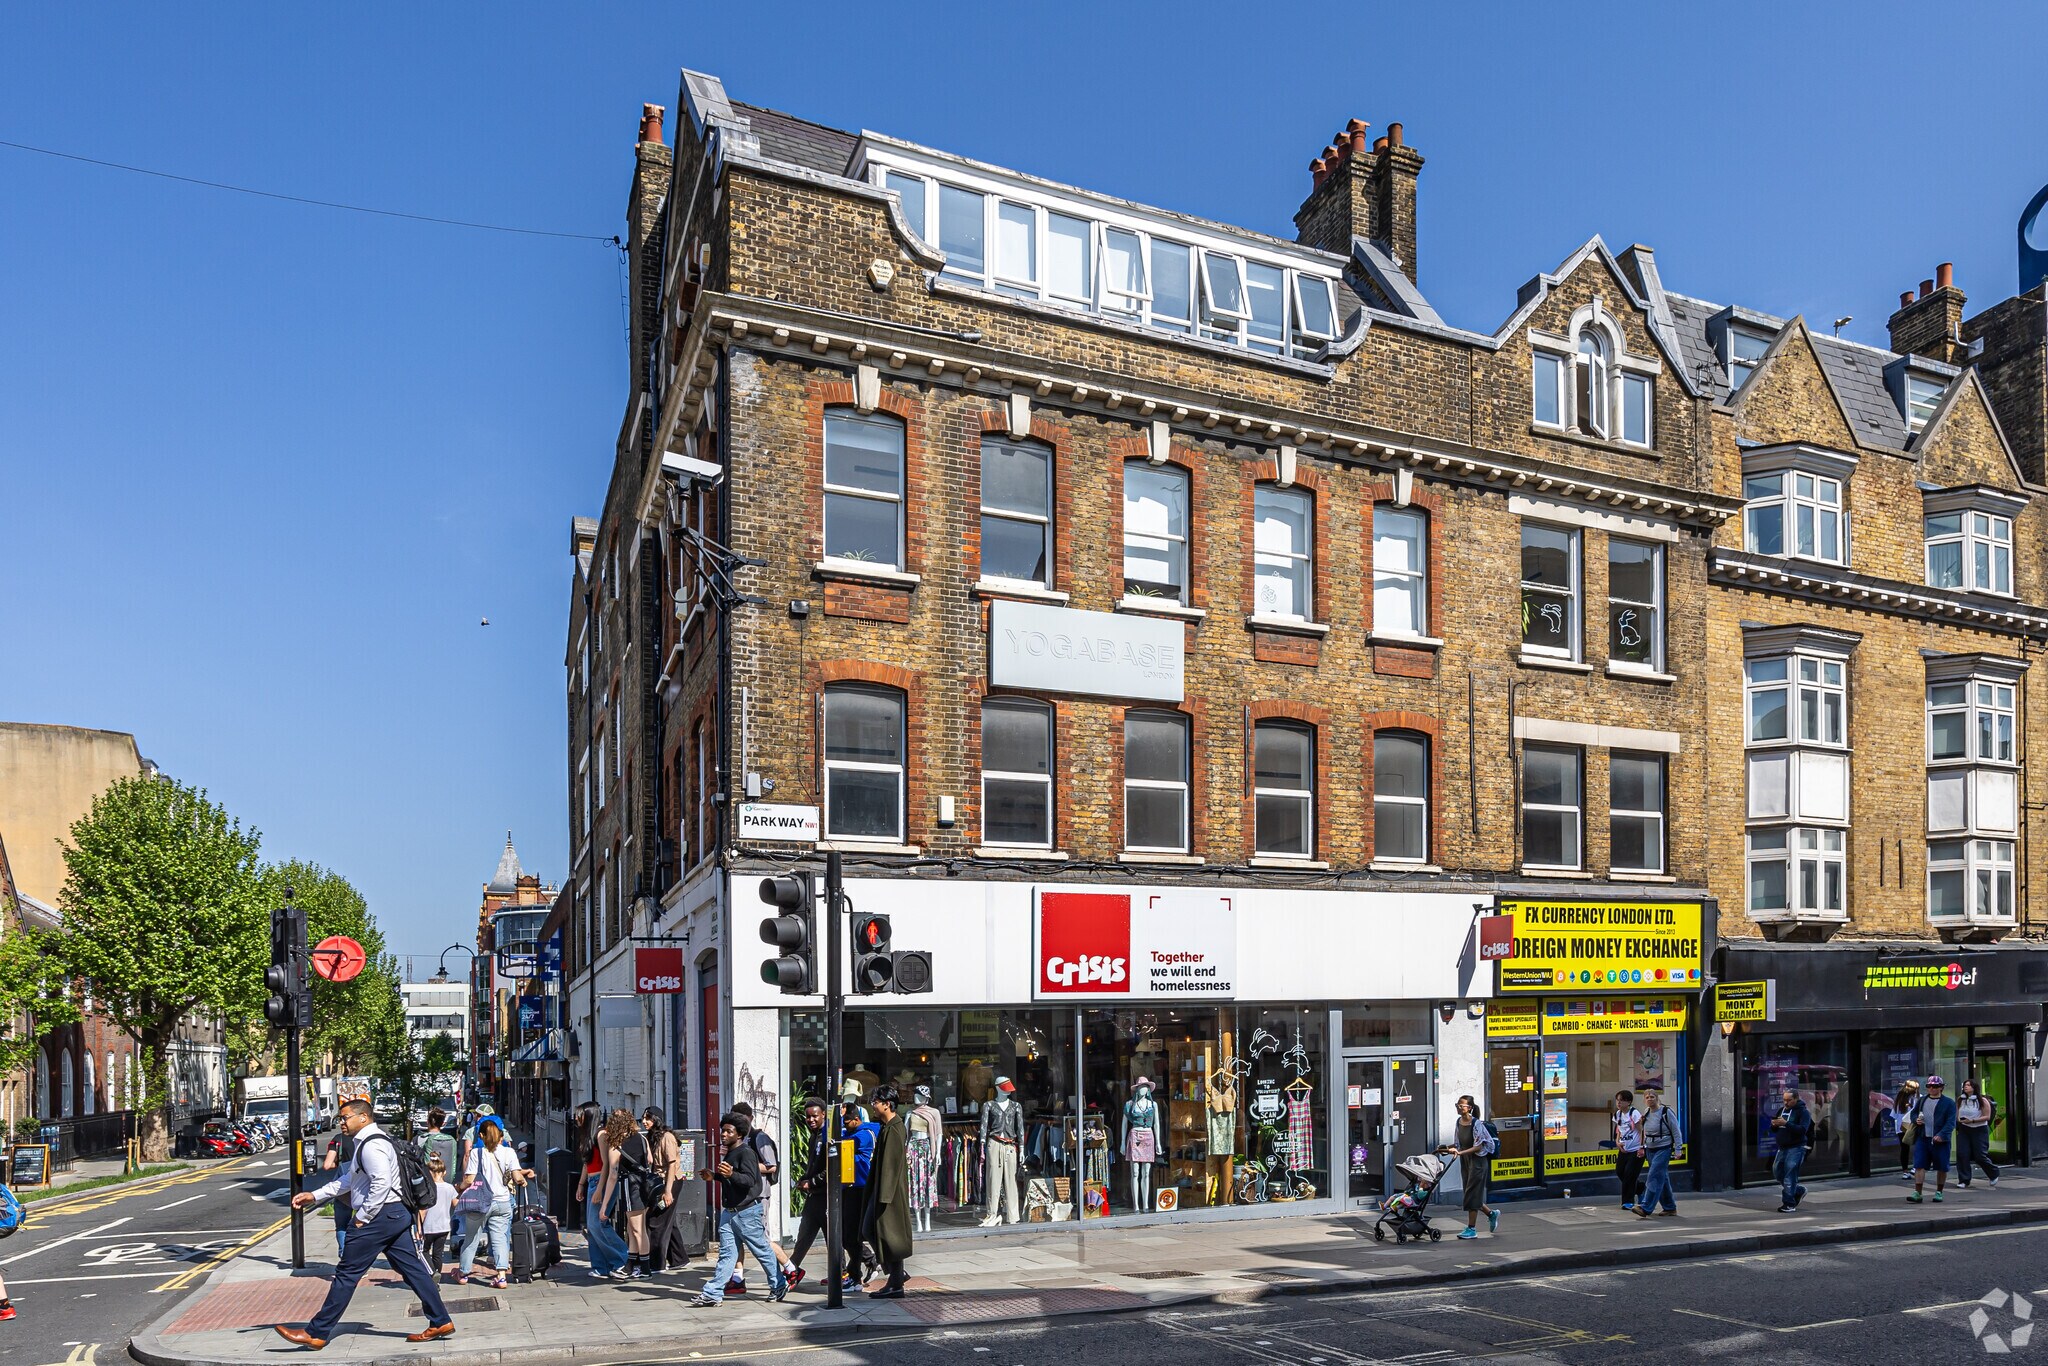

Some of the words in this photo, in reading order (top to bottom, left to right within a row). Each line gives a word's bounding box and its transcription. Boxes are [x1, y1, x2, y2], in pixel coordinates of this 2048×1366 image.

[1005, 628, 1174, 669] YOGABASE
[1144, 670, 1174, 680] LONDON
[744, 816, 804, 828] PARKWAY
[1526, 907, 1539, 924] FX
[1542, 907, 1606, 924] CURRENCY
[1608, 908, 1652, 924] LONDON
[1655, 909, 1676, 925] LTD.
[1514, 938, 1566, 959] OREIGN
[1571, 938, 1622, 958] MONEY
[1626, 939, 1697, 958] EXCHANGE
[1150, 952, 1204, 965] Together
[1150, 968, 1168, 976] we
[1170, 966, 1192, 976] will
[1194, 966, 1216, 976] end
[1150, 980, 1231, 991] homelessness
[1488, 1004, 1500, 1015] 0%
[1726, 1000, 1755, 1009] MONEY
[1719, 1010, 1762, 1019] EXCHANGE
[1552, 1020, 1579, 1031] CAMBIO
[1586, 1019, 1612, 1029] CHANGE
[1619, 1019, 1649, 1028] WECHSEL
[1656, 1018, 1678, 1028] VALUTA
[1498, 1160, 1529, 1168] INTERNATIONAL
[1546, 1158, 1566, 1169] SEND
[1567, 1158, 1573, 1167] &
[1575, 1155, 1604, 1167] RECEIVE
[1494, 1168, 1509, 1176] MONEY
